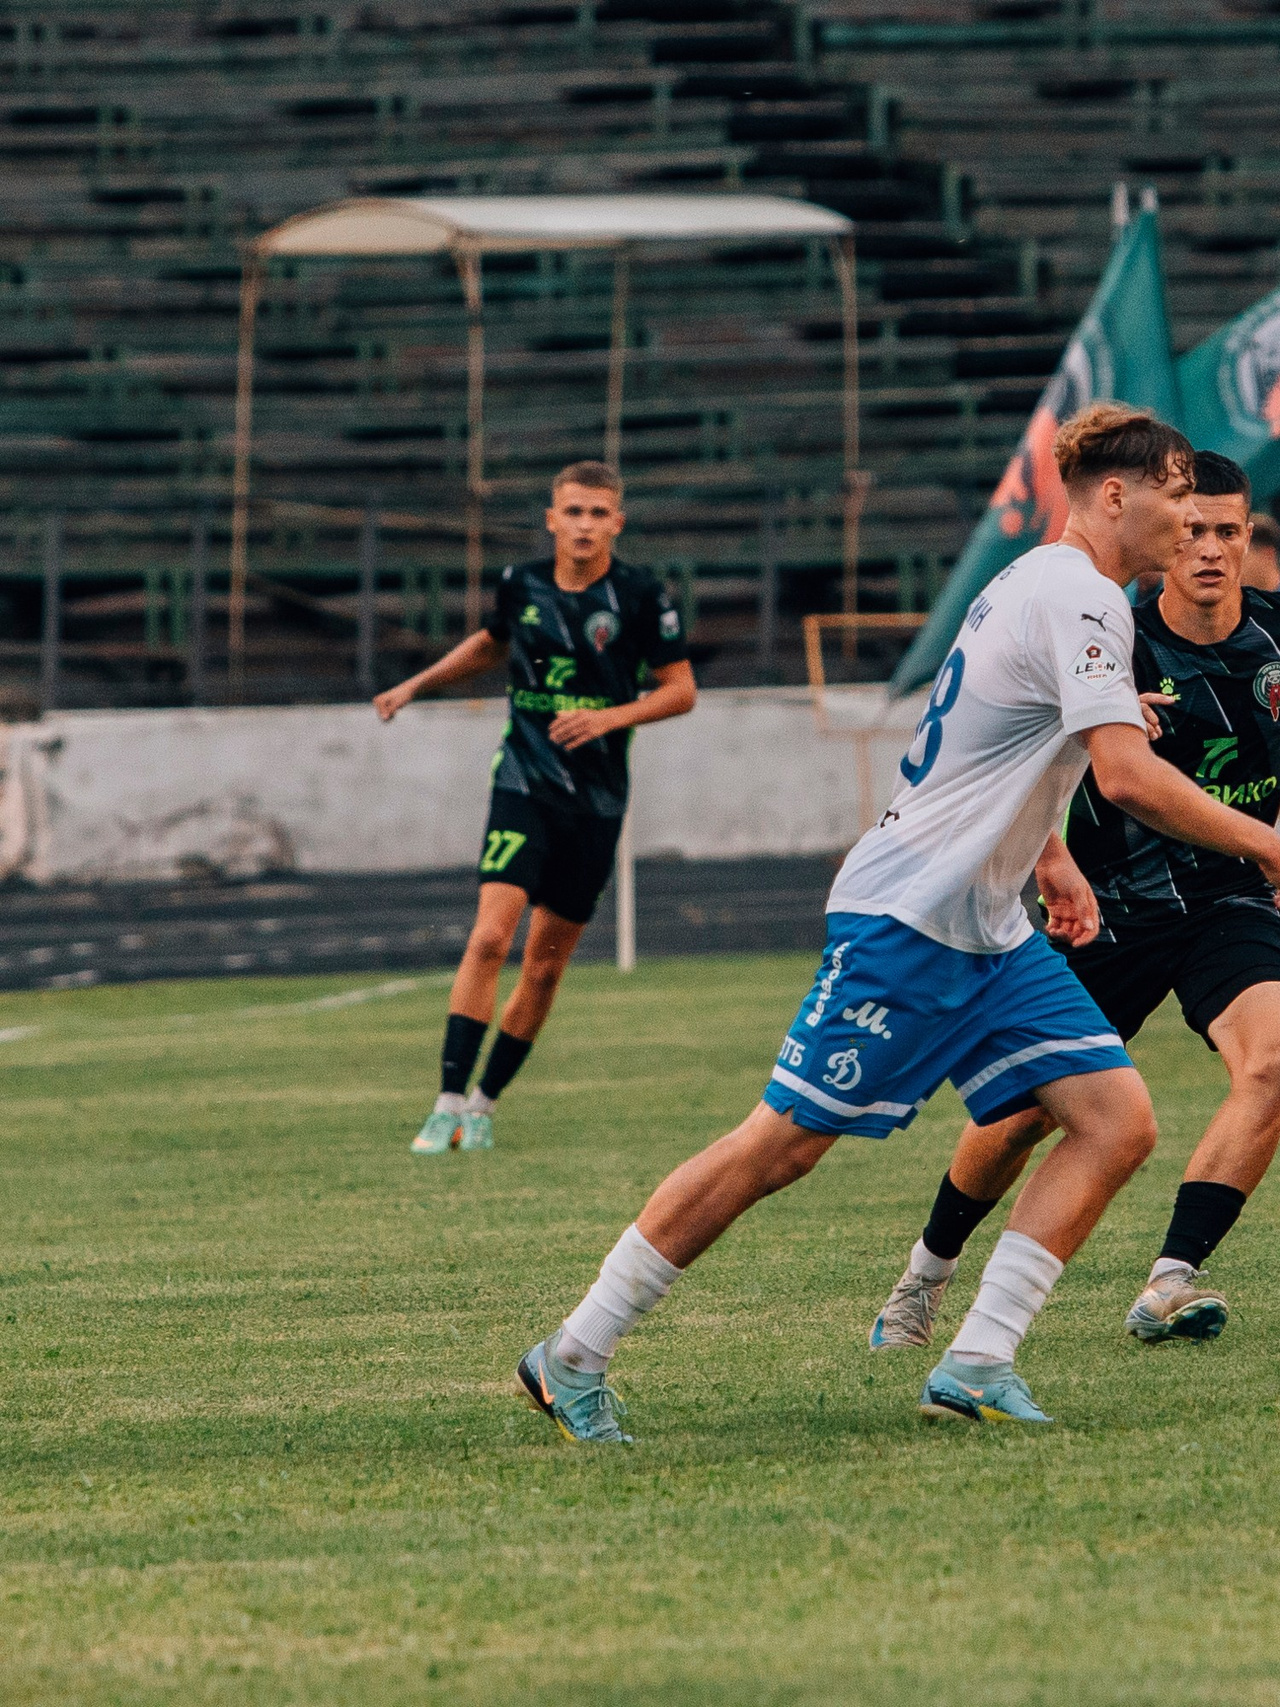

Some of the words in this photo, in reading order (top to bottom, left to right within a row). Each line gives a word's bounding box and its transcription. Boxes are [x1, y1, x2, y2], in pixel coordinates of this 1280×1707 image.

[480, 830, 527, 873] 27
[806, 942, 851, 1028] BetBoom
[779, 1034, 806, 1067] ТБ
